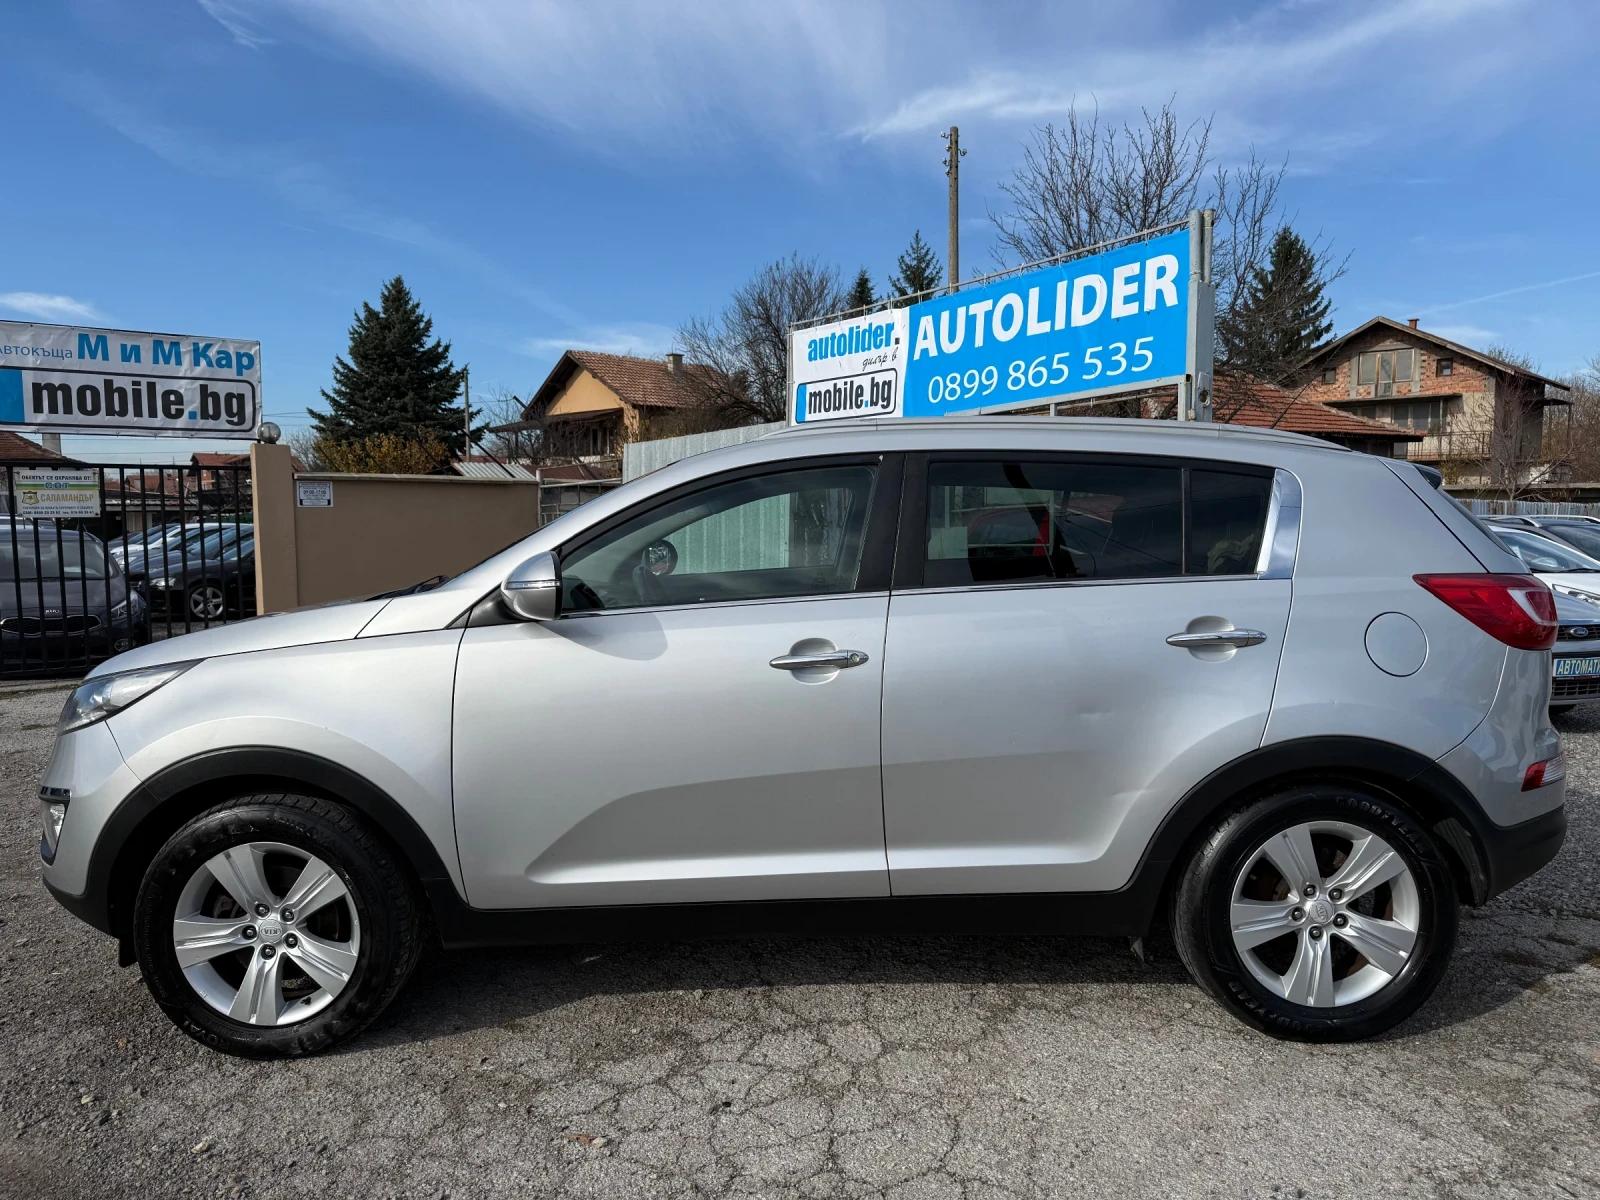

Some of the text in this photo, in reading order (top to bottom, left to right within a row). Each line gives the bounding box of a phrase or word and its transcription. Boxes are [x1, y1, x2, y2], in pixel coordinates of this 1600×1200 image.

[913, 254, 1179, 361] AUTOLIDER
[78, 333, 110, 361] М
[120, 343, 141, 364] и
[152, 340, 183, 366] М
[192, 342, 255, 376] Кар
[928, 336, 1154, 403] 0899 865 535
[31, 379, 247, 427] mobile.bg
[808, 376, 893, 414] mobile.bg
